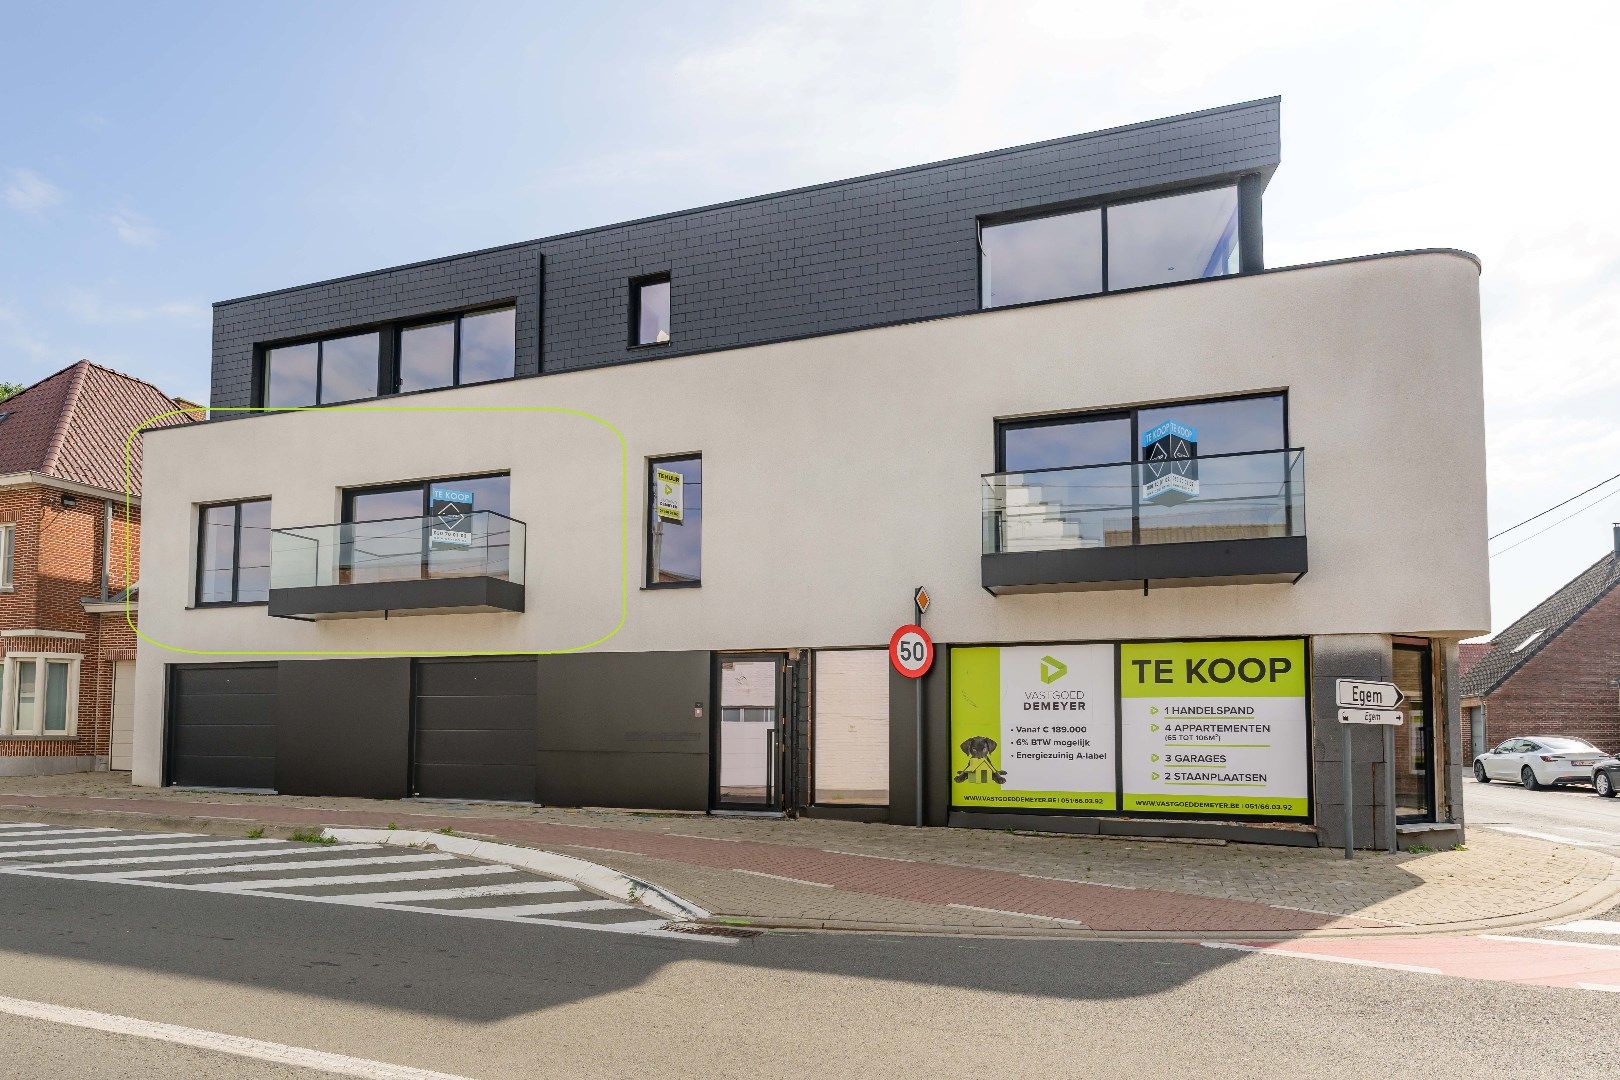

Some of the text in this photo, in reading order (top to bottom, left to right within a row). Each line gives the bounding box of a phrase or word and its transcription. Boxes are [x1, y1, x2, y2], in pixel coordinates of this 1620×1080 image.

[1153, 423, 1170, 439] KOOP
[434, 490, 470, 501] TE KOOP
[900, 641, 924, 662] 50
[1131, 657, 1292, 684] TE KOOP
[1024, 690, 1085, 700] VASTGOED
[1353, 686, 1382, 706] Egem
[1023, 701, 1086, 711] DEMEYER
[1172, 706, 1255, 715] HANDELSPAND
[1164, 724, 1271, 733] 4 APPARTEMENTEN
[1016, 738, 1029, 746] 6%
[1053, 738, 1091, 748] mogelijk
[1016, 752, 1107, 761] Energiezuinig A-label
[1165, 754, 1227, 763] 3 GARAGES
[1164, 772, 1267, 783] 2 STAANPLAATSEN
[1135, 800, 1293, 811] WWW.VASTGOEDDEMEYER.BE 051/66.03.92
